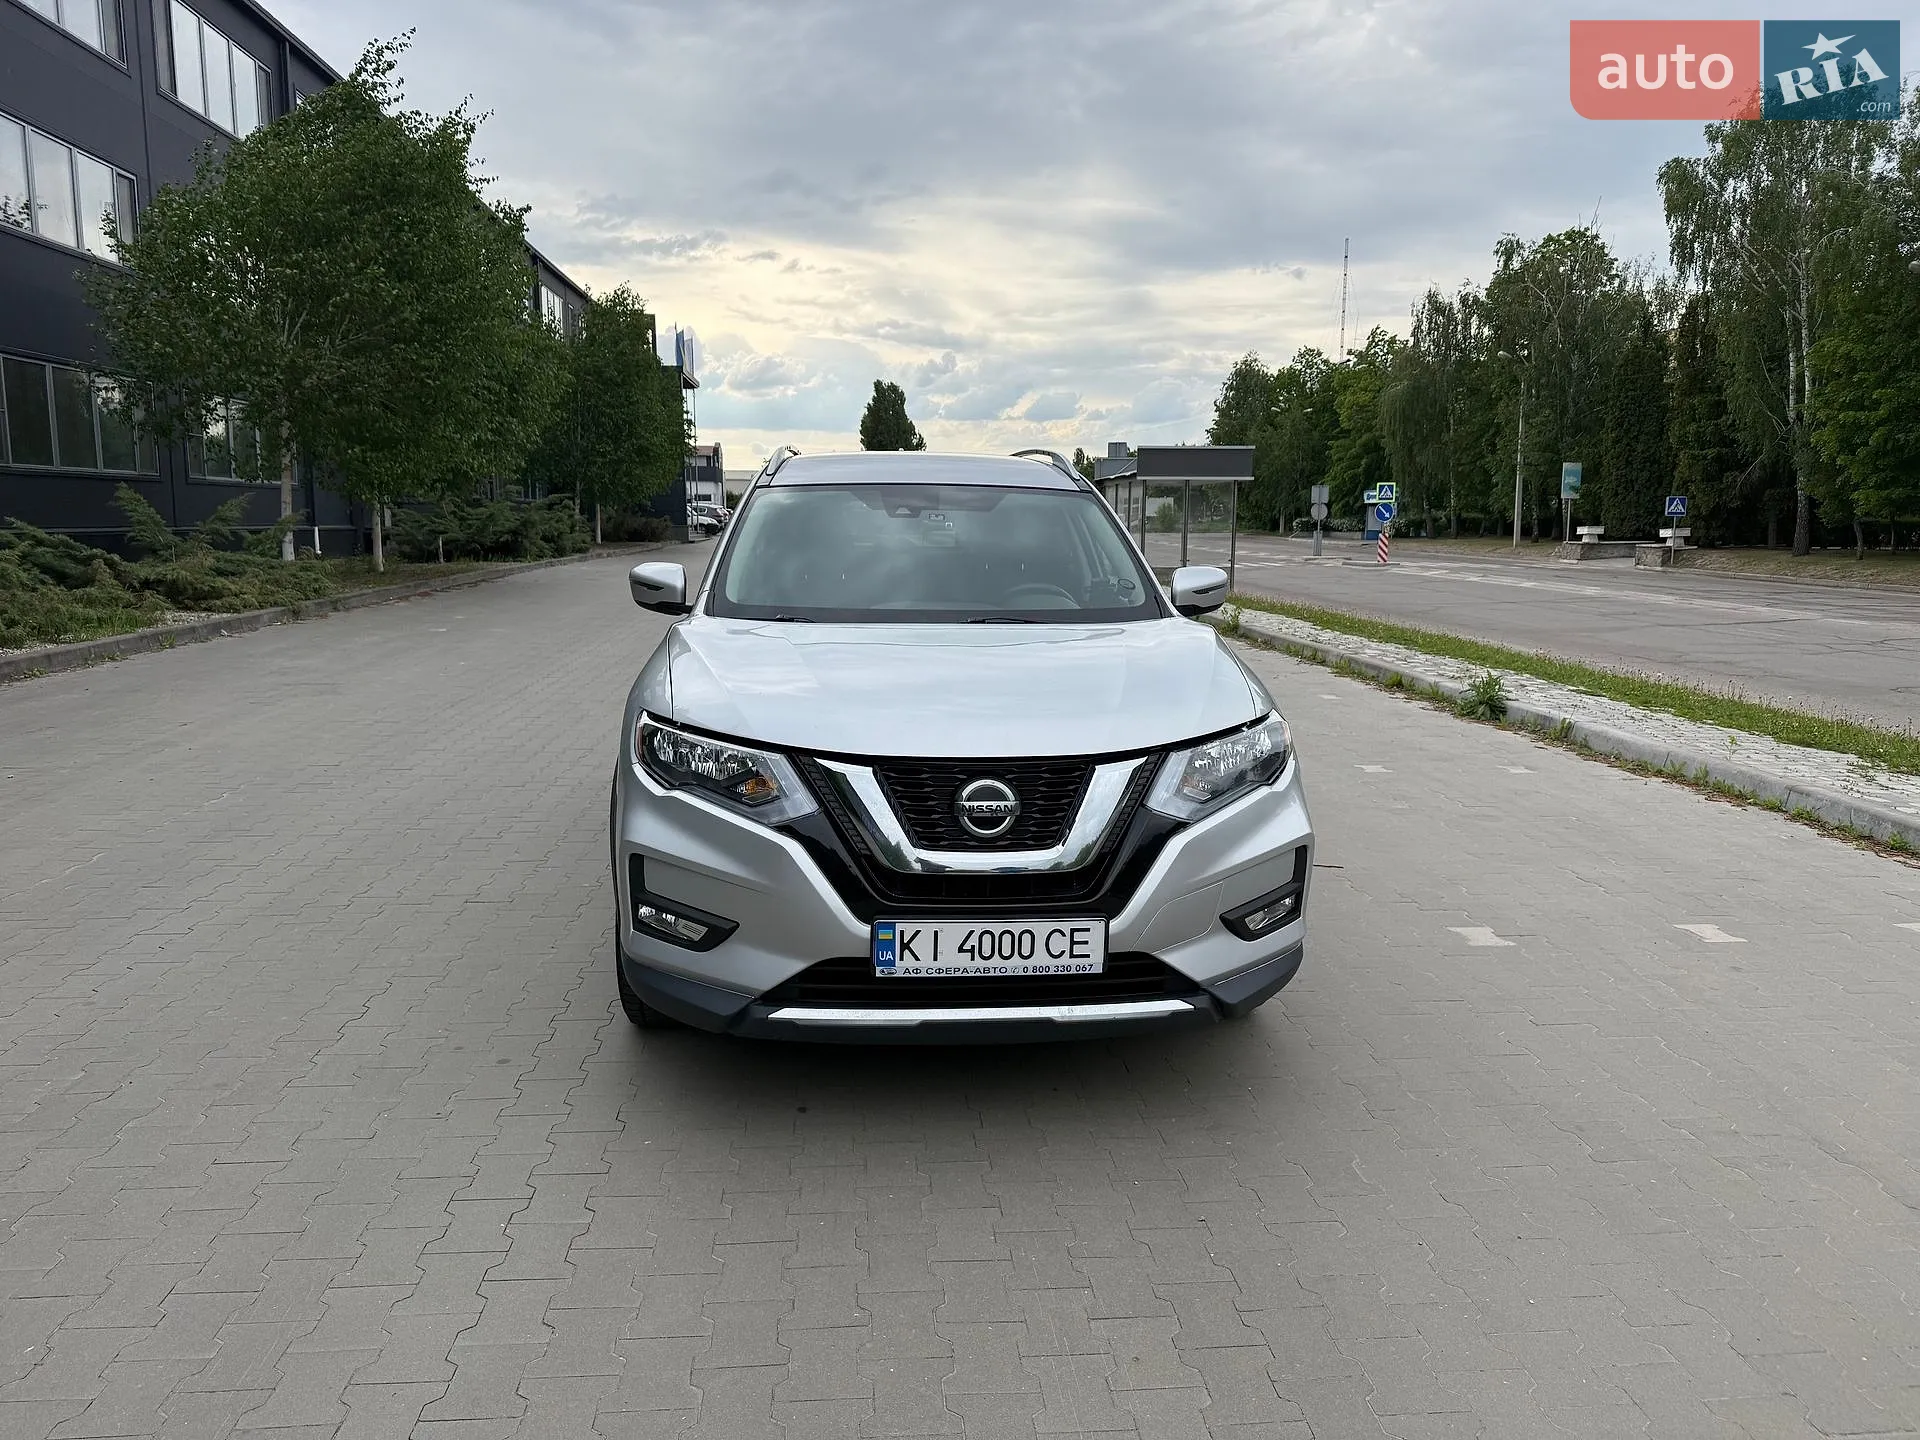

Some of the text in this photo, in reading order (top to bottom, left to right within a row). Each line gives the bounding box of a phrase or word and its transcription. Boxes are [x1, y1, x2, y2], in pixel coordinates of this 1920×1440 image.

[961, 804, 1013, 813] NISSAN
[957, 928, 1036, 962] 4000
[1045, 928, 1091, 960] CE
[878, 950, 894, 961] UA
[902, 963, 1094, 976] АФ СФЕРА-АВТО 0 800 330 067
